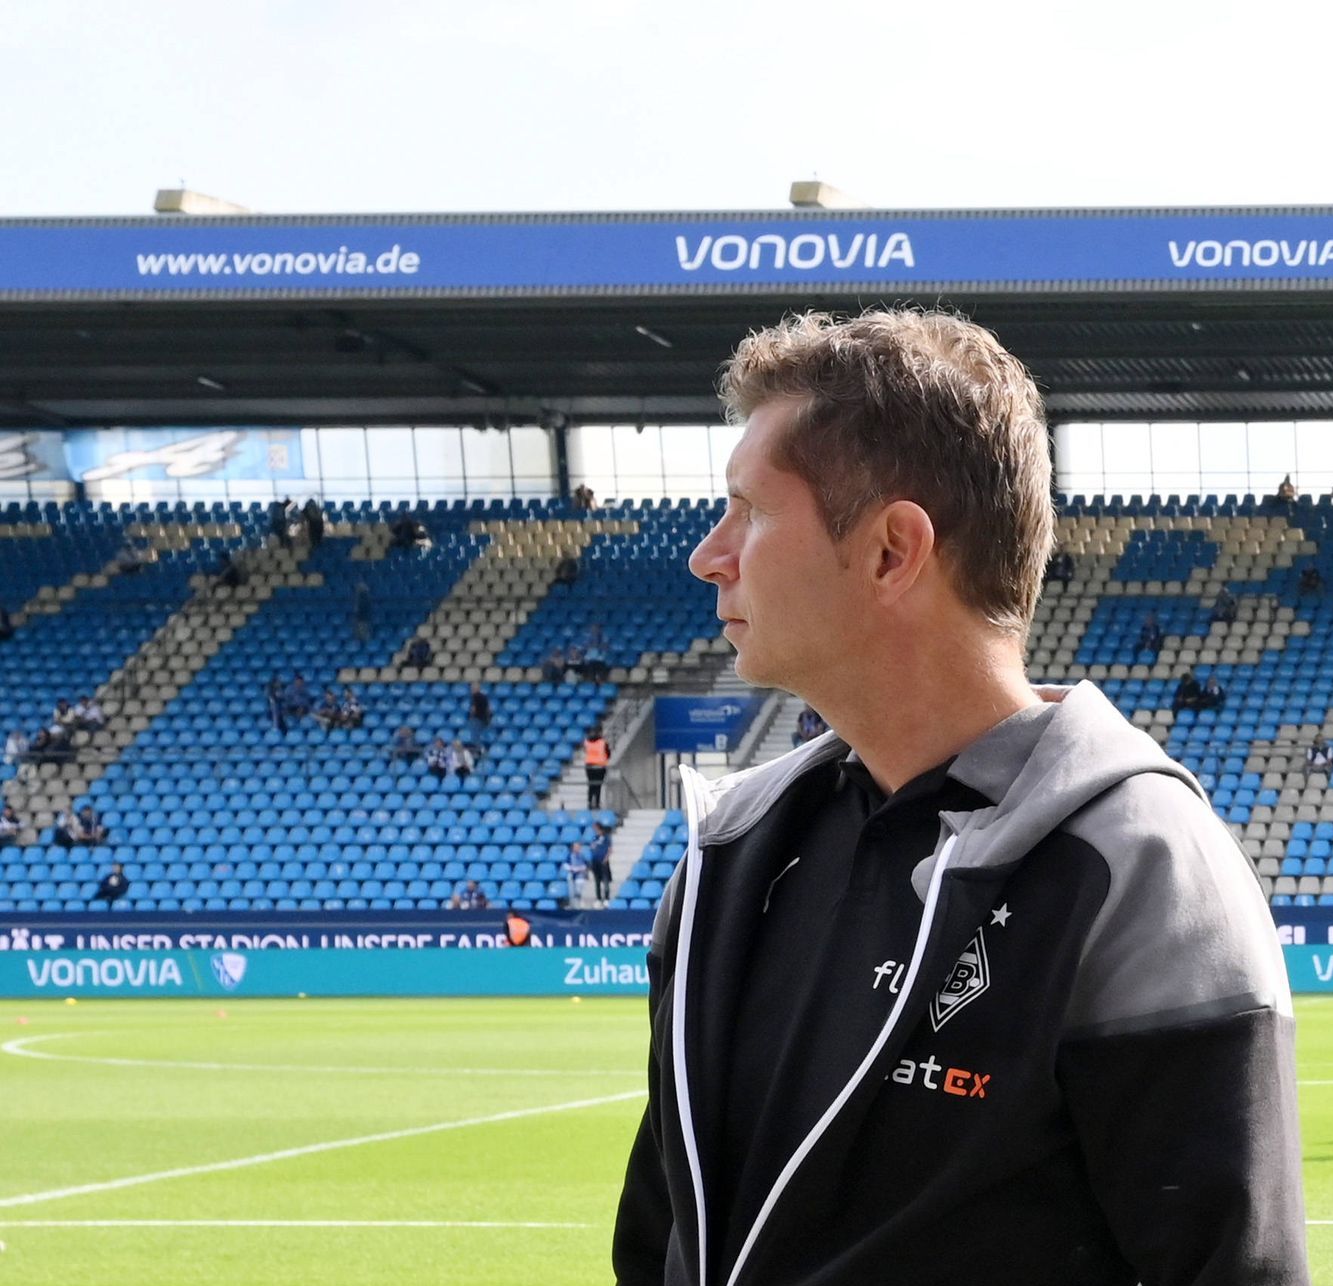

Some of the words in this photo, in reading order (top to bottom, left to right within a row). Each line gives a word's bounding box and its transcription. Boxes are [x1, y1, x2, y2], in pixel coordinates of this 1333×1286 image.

[136, 245, 420, 276] www.vonovia.de
[675, 232, 915, 271] VONOVIA
[27, 958, 182, 986] VONOVIA
[564, 957, 650, 984] Zuhau
